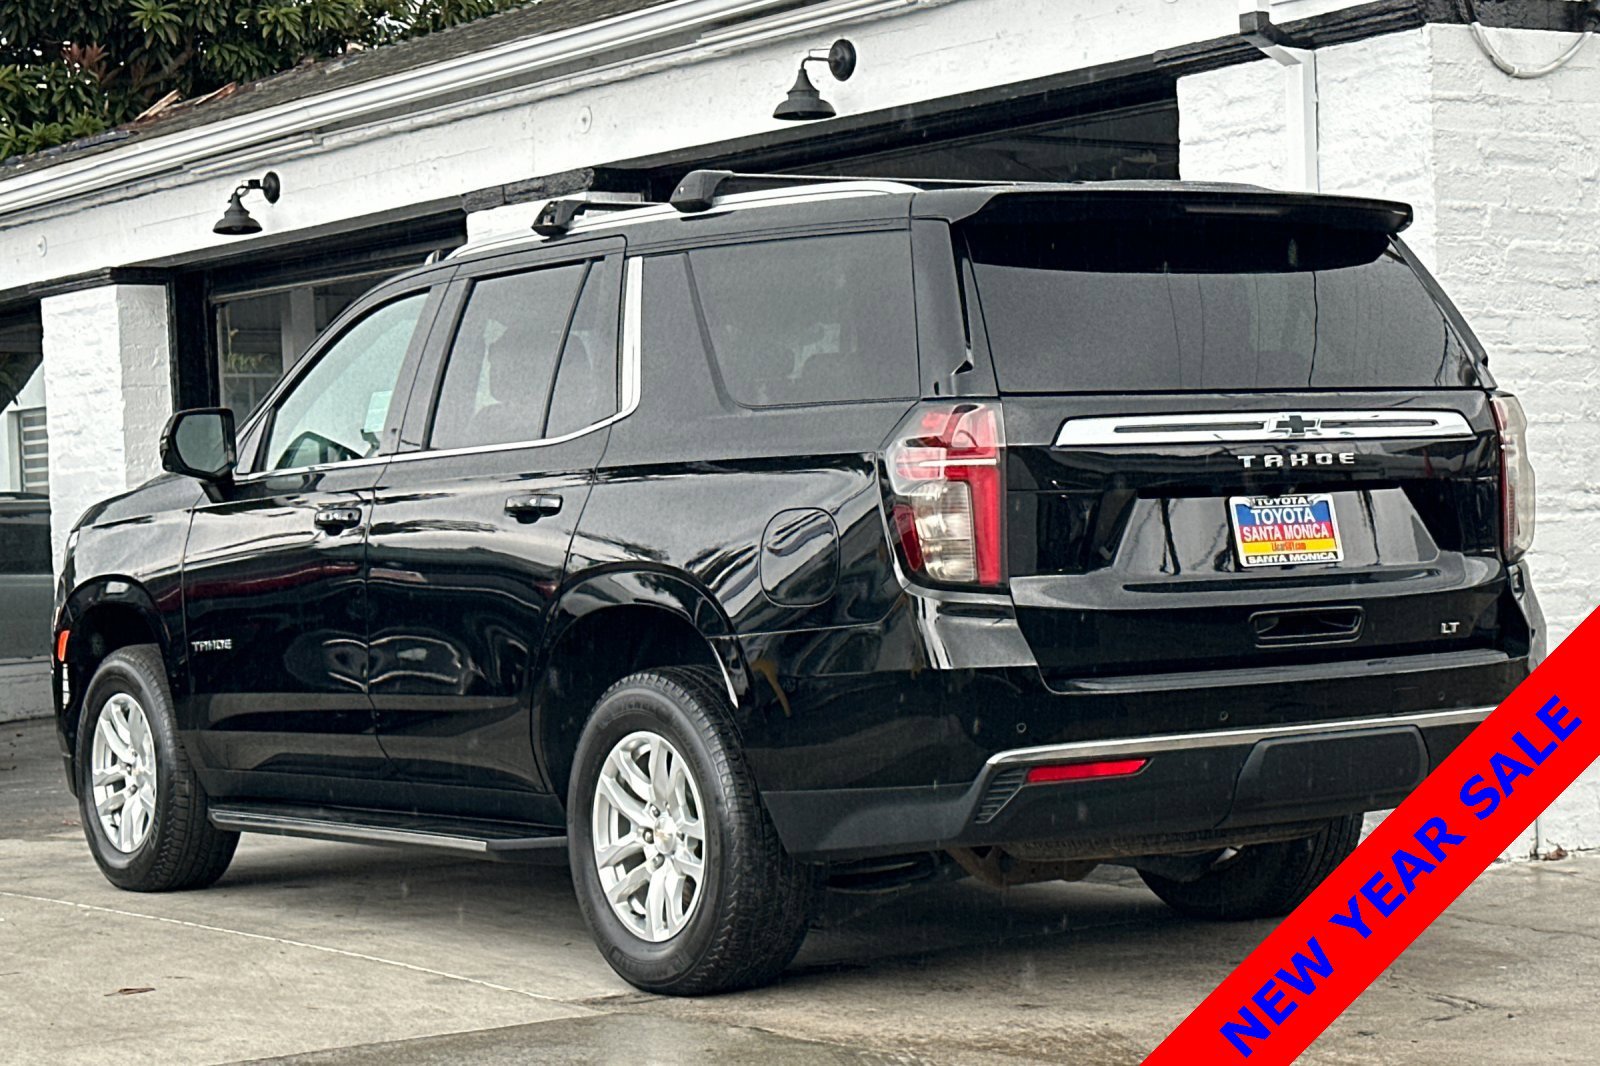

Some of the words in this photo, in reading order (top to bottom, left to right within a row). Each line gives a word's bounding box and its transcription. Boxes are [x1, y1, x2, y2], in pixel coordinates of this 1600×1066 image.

[1237, 452, 1355, 468] TAHOE
[1257, 497, 1307, 506] TOYOTA
[1250, 507, 1316, 525] TOYOTA
[1243, 526, 1283, 542] SANTA
[1284, 523, 1329, 540] MONICA
[1248, 555, 1287, 564] SANTA
[1289, 552, 1336, 562] MONICA
[1441, 621, 1460, 633] LT
[191, 639, 232, 651] TAHOE
